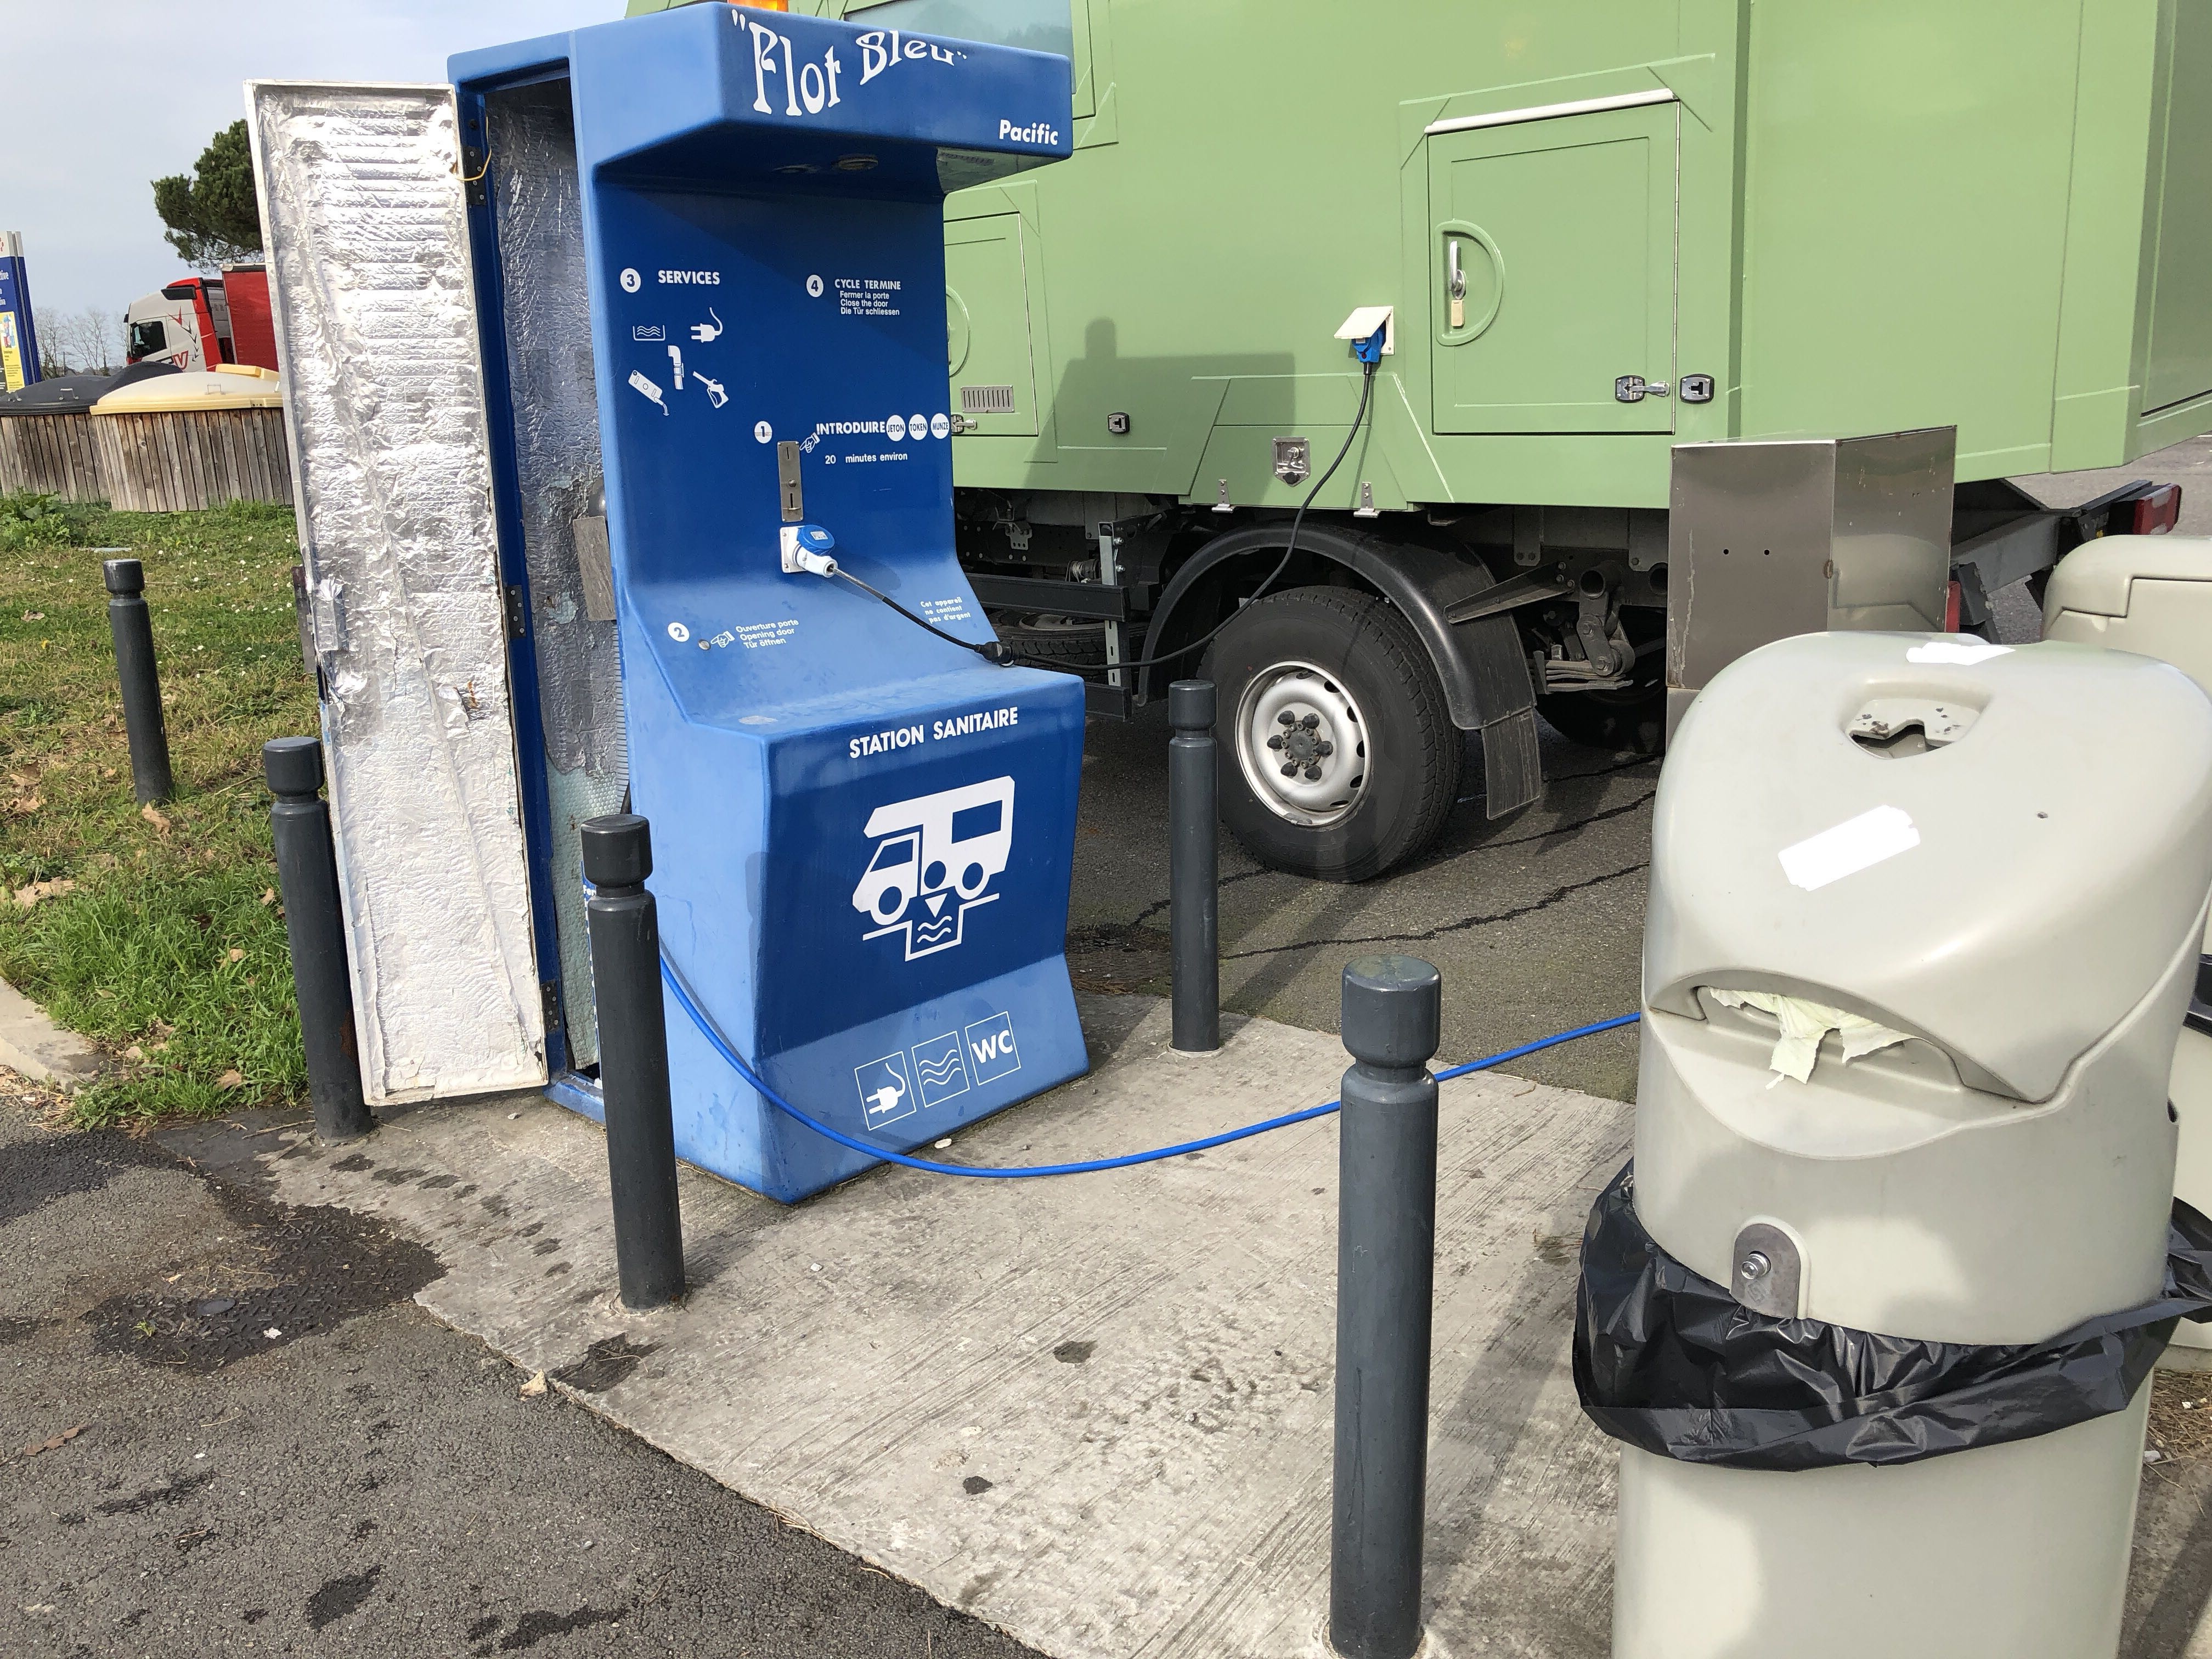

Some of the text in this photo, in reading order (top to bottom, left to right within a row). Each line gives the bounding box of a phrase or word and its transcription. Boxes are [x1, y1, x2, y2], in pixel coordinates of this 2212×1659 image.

[998, 120, 1058, 146] Pacific
[627, 270, 720, 287] 3 SERVICES
[811, 279, 901, 292] 4 CYCLE TERMINE
[840, 307, 851, 315] Die
[816, 421, 885, 435] INTRODUIRE
[888, 424, 905, 433] JETON
[910, 422, 927, 432] TOKEN
[932, 422, 949, 431] MUNZE
[825, 452, 908, 465] 20 minutes environ
[935, 596, 963, 607] appareil
[936, 605, 963, 613] contient
[944, 612, 971, 620] d'argent
[674, 619, 799, 638] 2 Ouverture porte
[740, 628, 794, 641] Opening door
[743, 637, 786, 649] Tür öffnen
[850, 706, 1018, 759] STATION SANITAIRE
[971, 1029, 1014, 1064] WC
